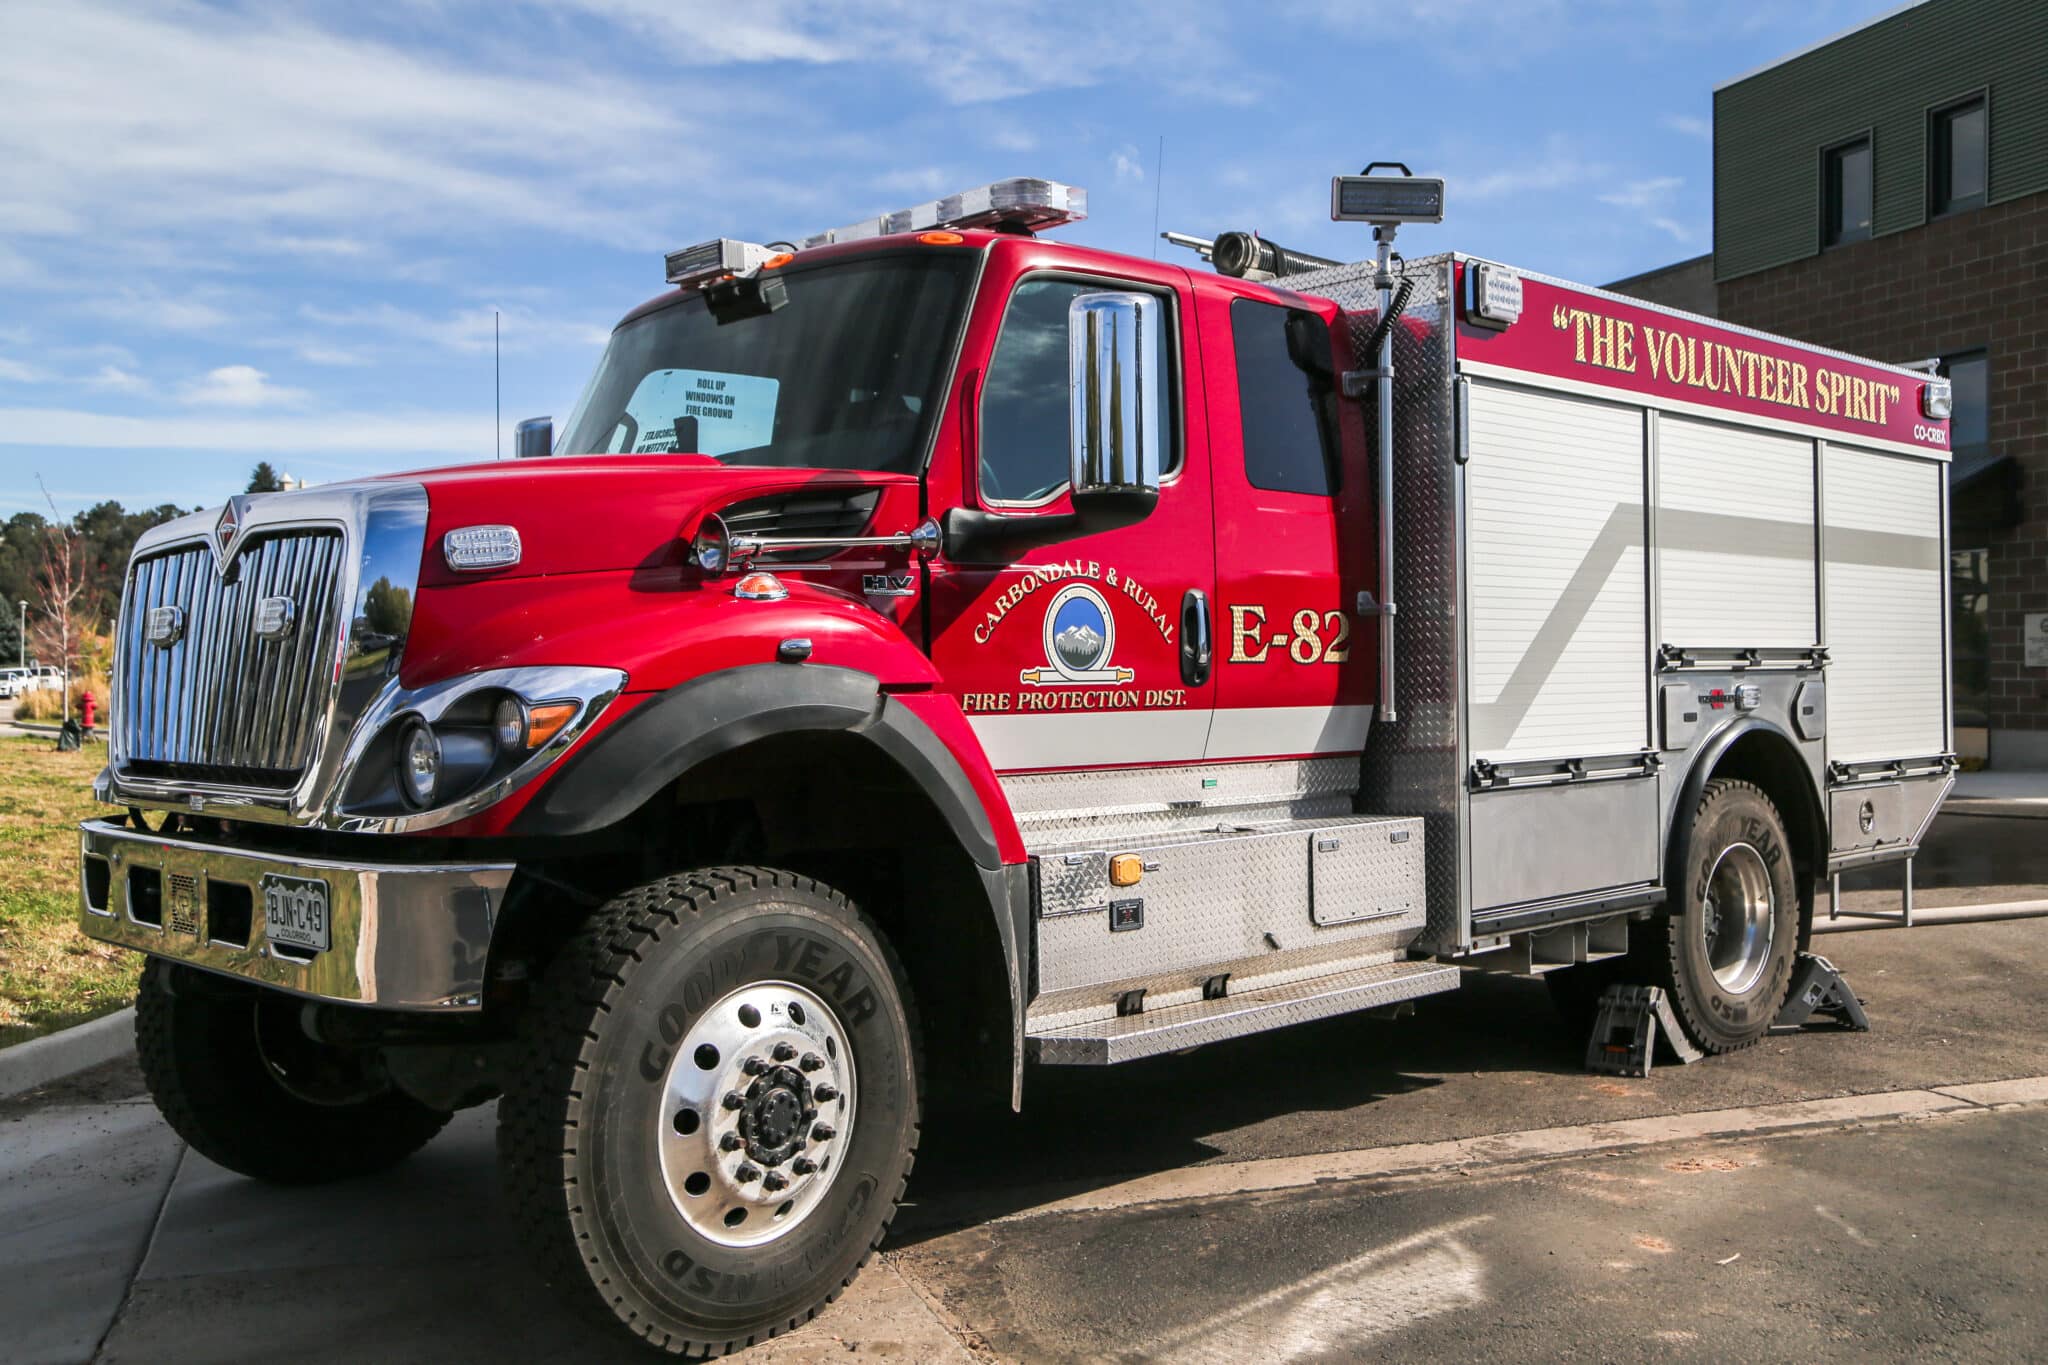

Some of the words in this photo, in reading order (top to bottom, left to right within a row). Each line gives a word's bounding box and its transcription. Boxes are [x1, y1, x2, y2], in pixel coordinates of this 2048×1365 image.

[1643, 326, 1810, 410] VOLUNTEER
[697, 378, 714, 390] ROLL
[715, 379, 726, 391] UP
[685, 390, 724, 405] WINDOWS
[724, 395, 735, 406] ON
[685, 404, 701, 416] FIRE
[702, 406, 733, 419] GROUND
[1913, 423, 1946, 446] CO-CRBX
[863, 575, 914, 590] HV
[973, 559, 1101, 645] CARBONDALE
[1105, 567, 1119, 587] &
[1123, 575, 1174, 645] RURAL
[1227, 603, 1351, 665] E-82
[962, 693, 1011, 712] FIRE
[1016, 690, 1140, 711] PROTECTION
[1145, 688, 1187, 708] DIST.
[280, 928, 312, 942] COLORADO
